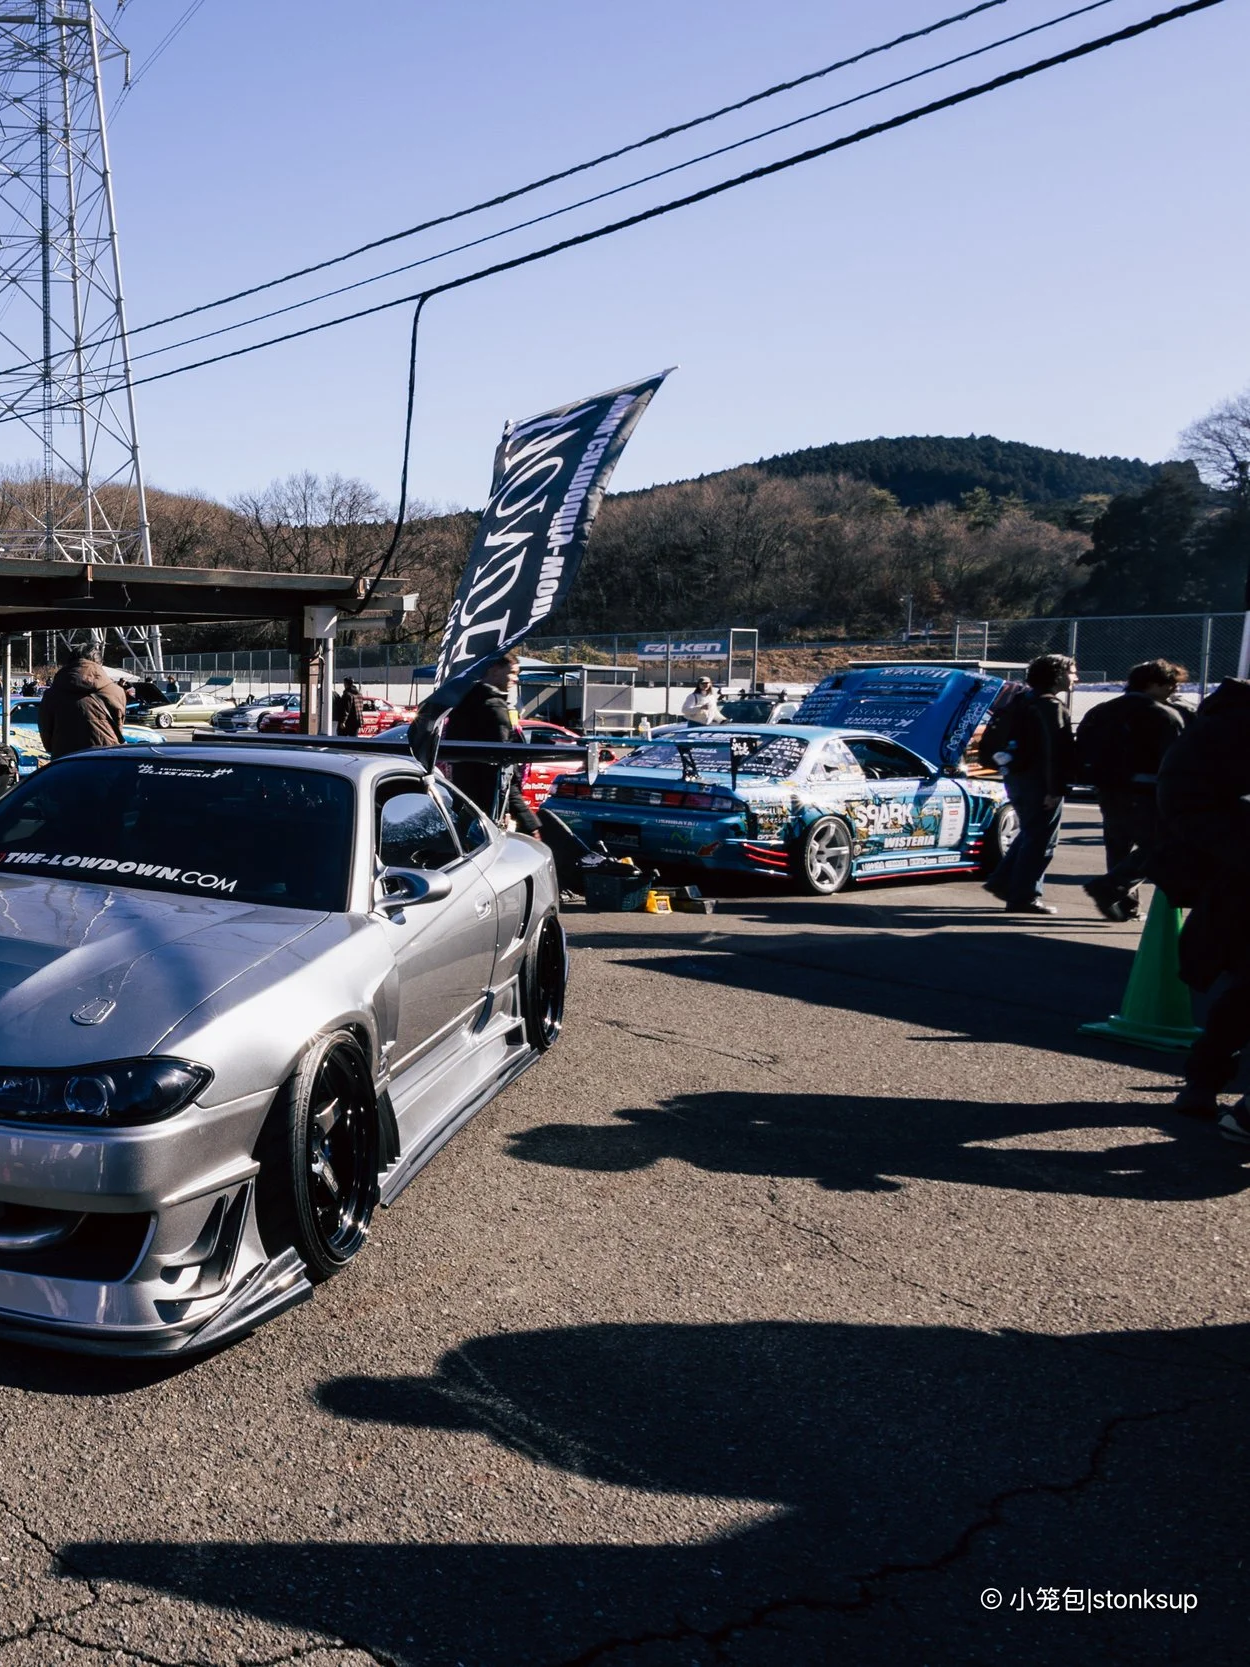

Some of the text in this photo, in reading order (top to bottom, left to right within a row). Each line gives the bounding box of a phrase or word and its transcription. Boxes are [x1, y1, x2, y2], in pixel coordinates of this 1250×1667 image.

[643, 643, 721, 652] FALKEN
[883, 835, 936, 849] WISTERIA
[4, 852, 238, 893] THE-LOWDOWN.COM
